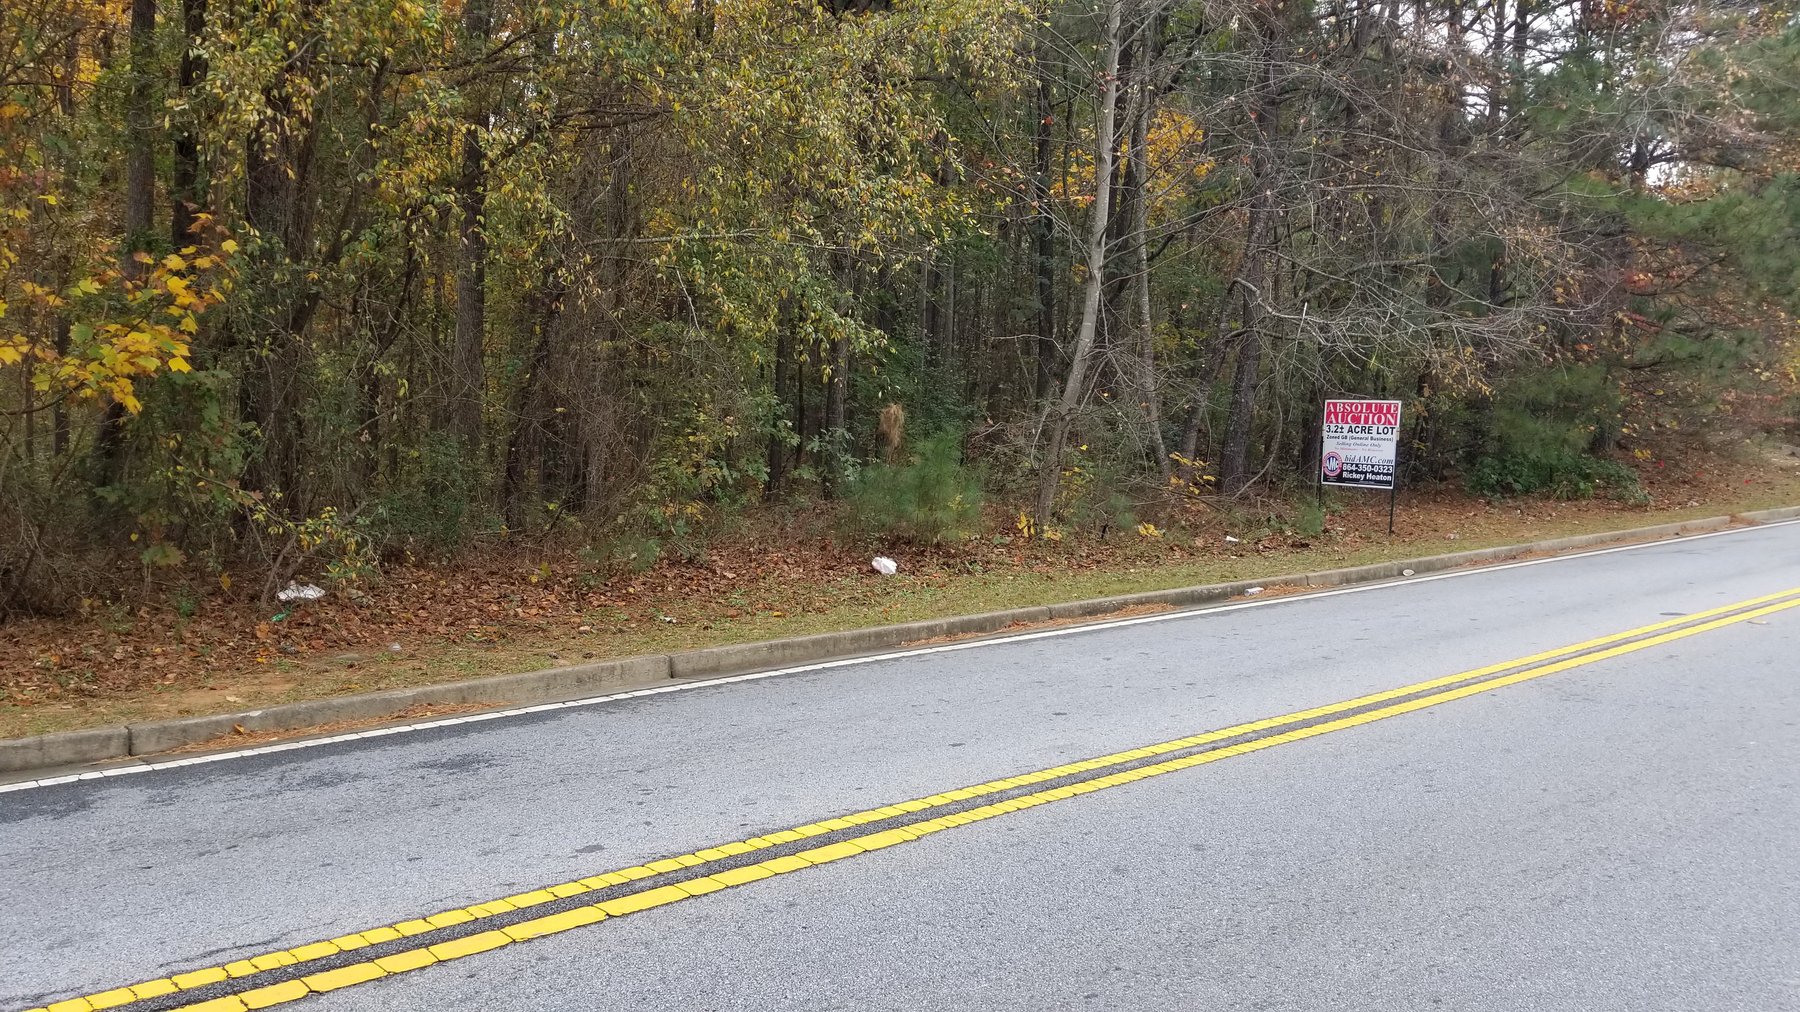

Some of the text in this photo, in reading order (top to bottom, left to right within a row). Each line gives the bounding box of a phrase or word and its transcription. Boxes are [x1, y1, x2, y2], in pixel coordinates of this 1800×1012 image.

[1327, 403, 1398, 413] ABSOLUTE
[1327, 413, 1396, 425] AUCTION
[1326, 425, 1395, 435] 3.2± ACRE LOT
[1343, 472, 1365, 481] Rickey
[1367, 473, 1392, 481] Heaton
